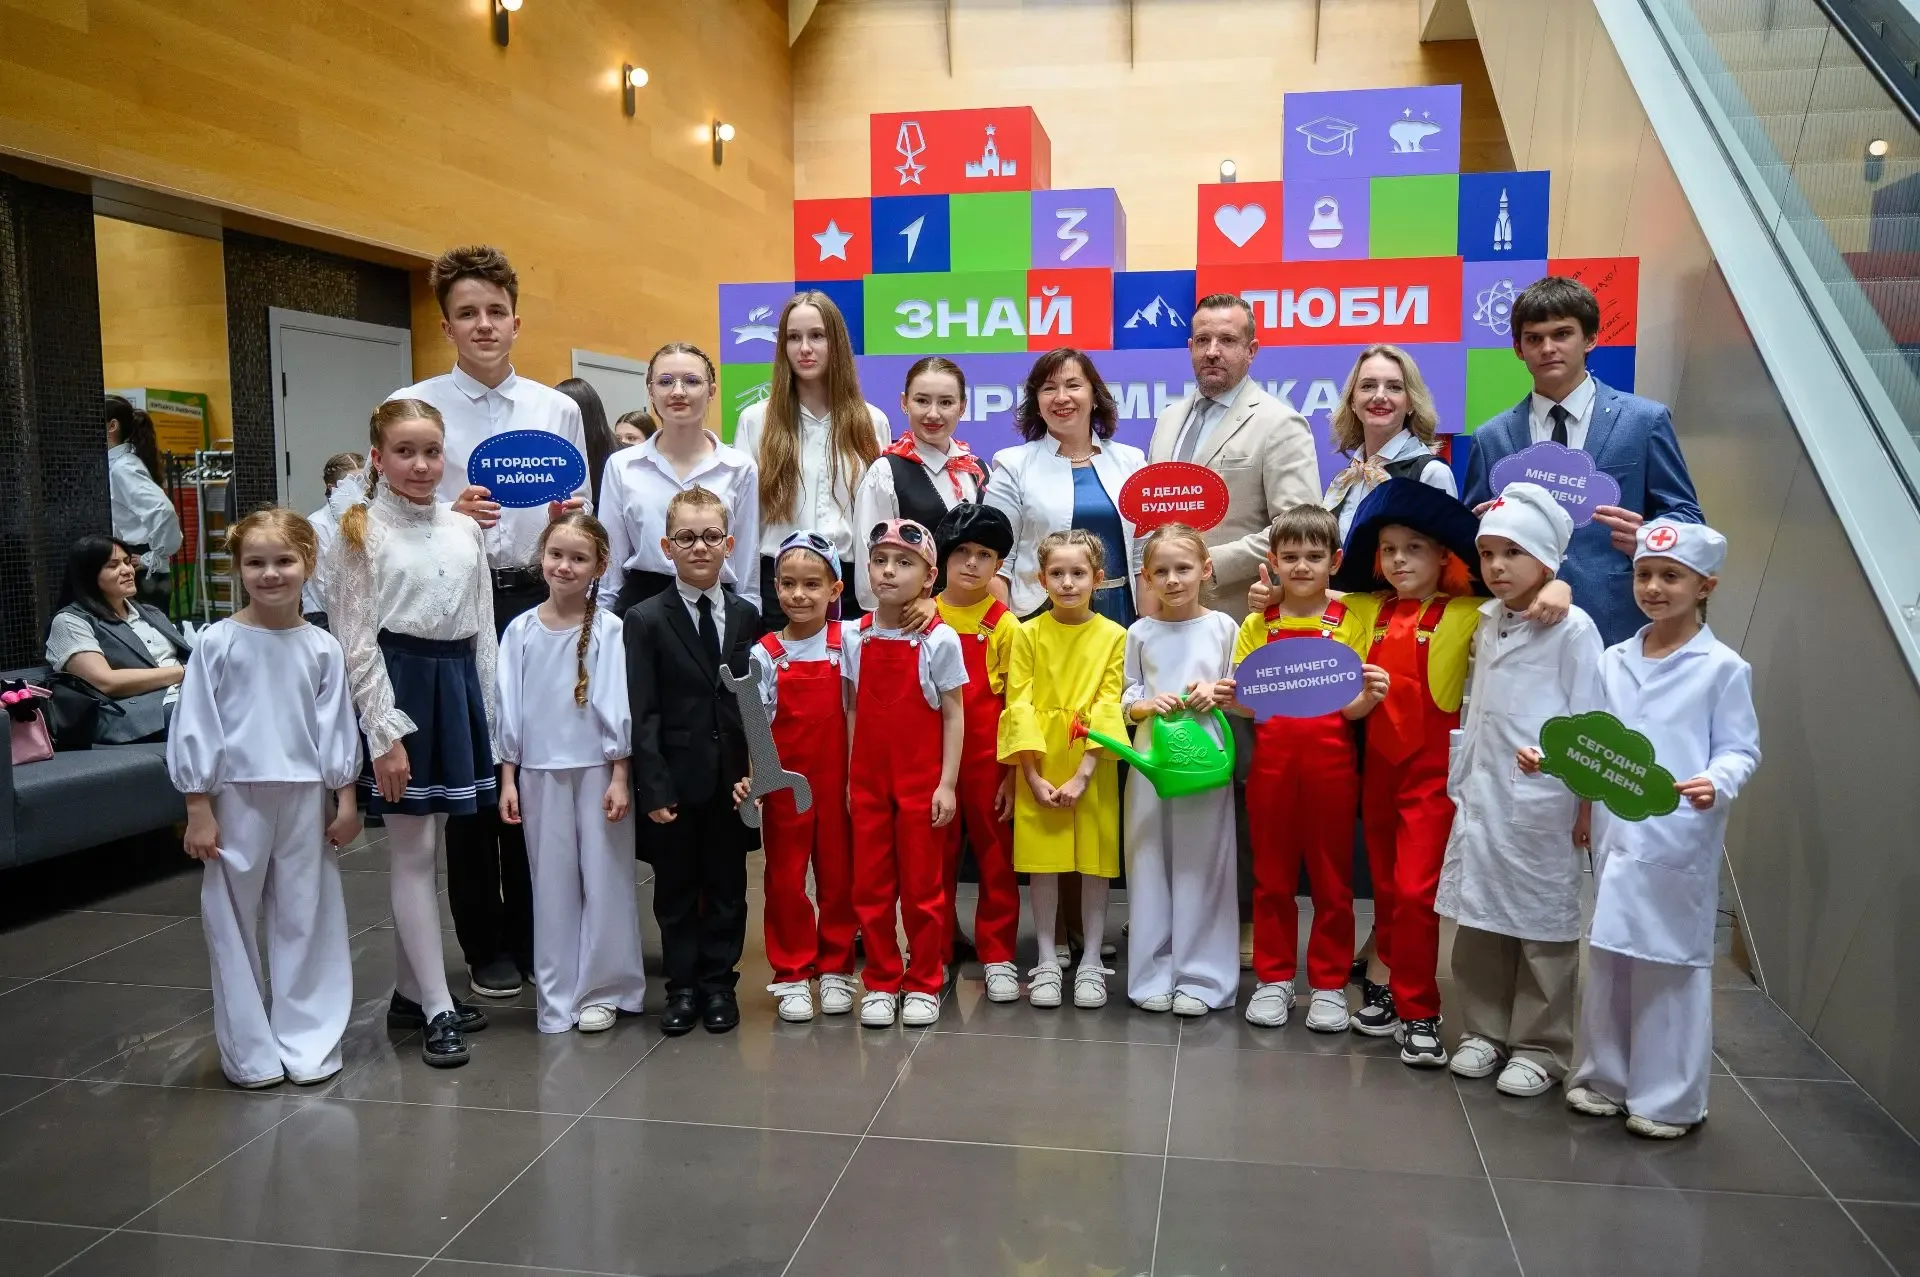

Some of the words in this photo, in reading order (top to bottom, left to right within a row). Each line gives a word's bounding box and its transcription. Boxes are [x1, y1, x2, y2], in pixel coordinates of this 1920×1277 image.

[894, 285, 1073, 339] ЗНАЙ
[1240, 285, 1429, 329] ЛЮБИ
[481, 458, 491, 469] Я
[494, 456, 567, 469] ГОРДОСТЬ
[496, 471, 555, 484] РАЙОНА
[1525, 468, 1556, 483] МНЕ
[1558, 476, 1587, 489] ВСЁ
[1141, 487, 1151, 497] Я
[1153, 485, 1203, 498] ДЕЛАЮ
[1547, 488, 1588, 505] ЛЕЧУ
[1141, 500, 1205, 513] БУДУЩЕЕ
[1256, 666, 1281, 679] НЕТ
[1284, 658, 1338, 675] НИЧЕГО
[1243, 671, 1357, 696] НЕВОЗМОЖНОГО
[1577, 734, 1648, 779] СЕГОДНЯ
[1566, 747, 1602, 774] МОЙ
[1601, 768, 1645, 797] ДЕНЬ
